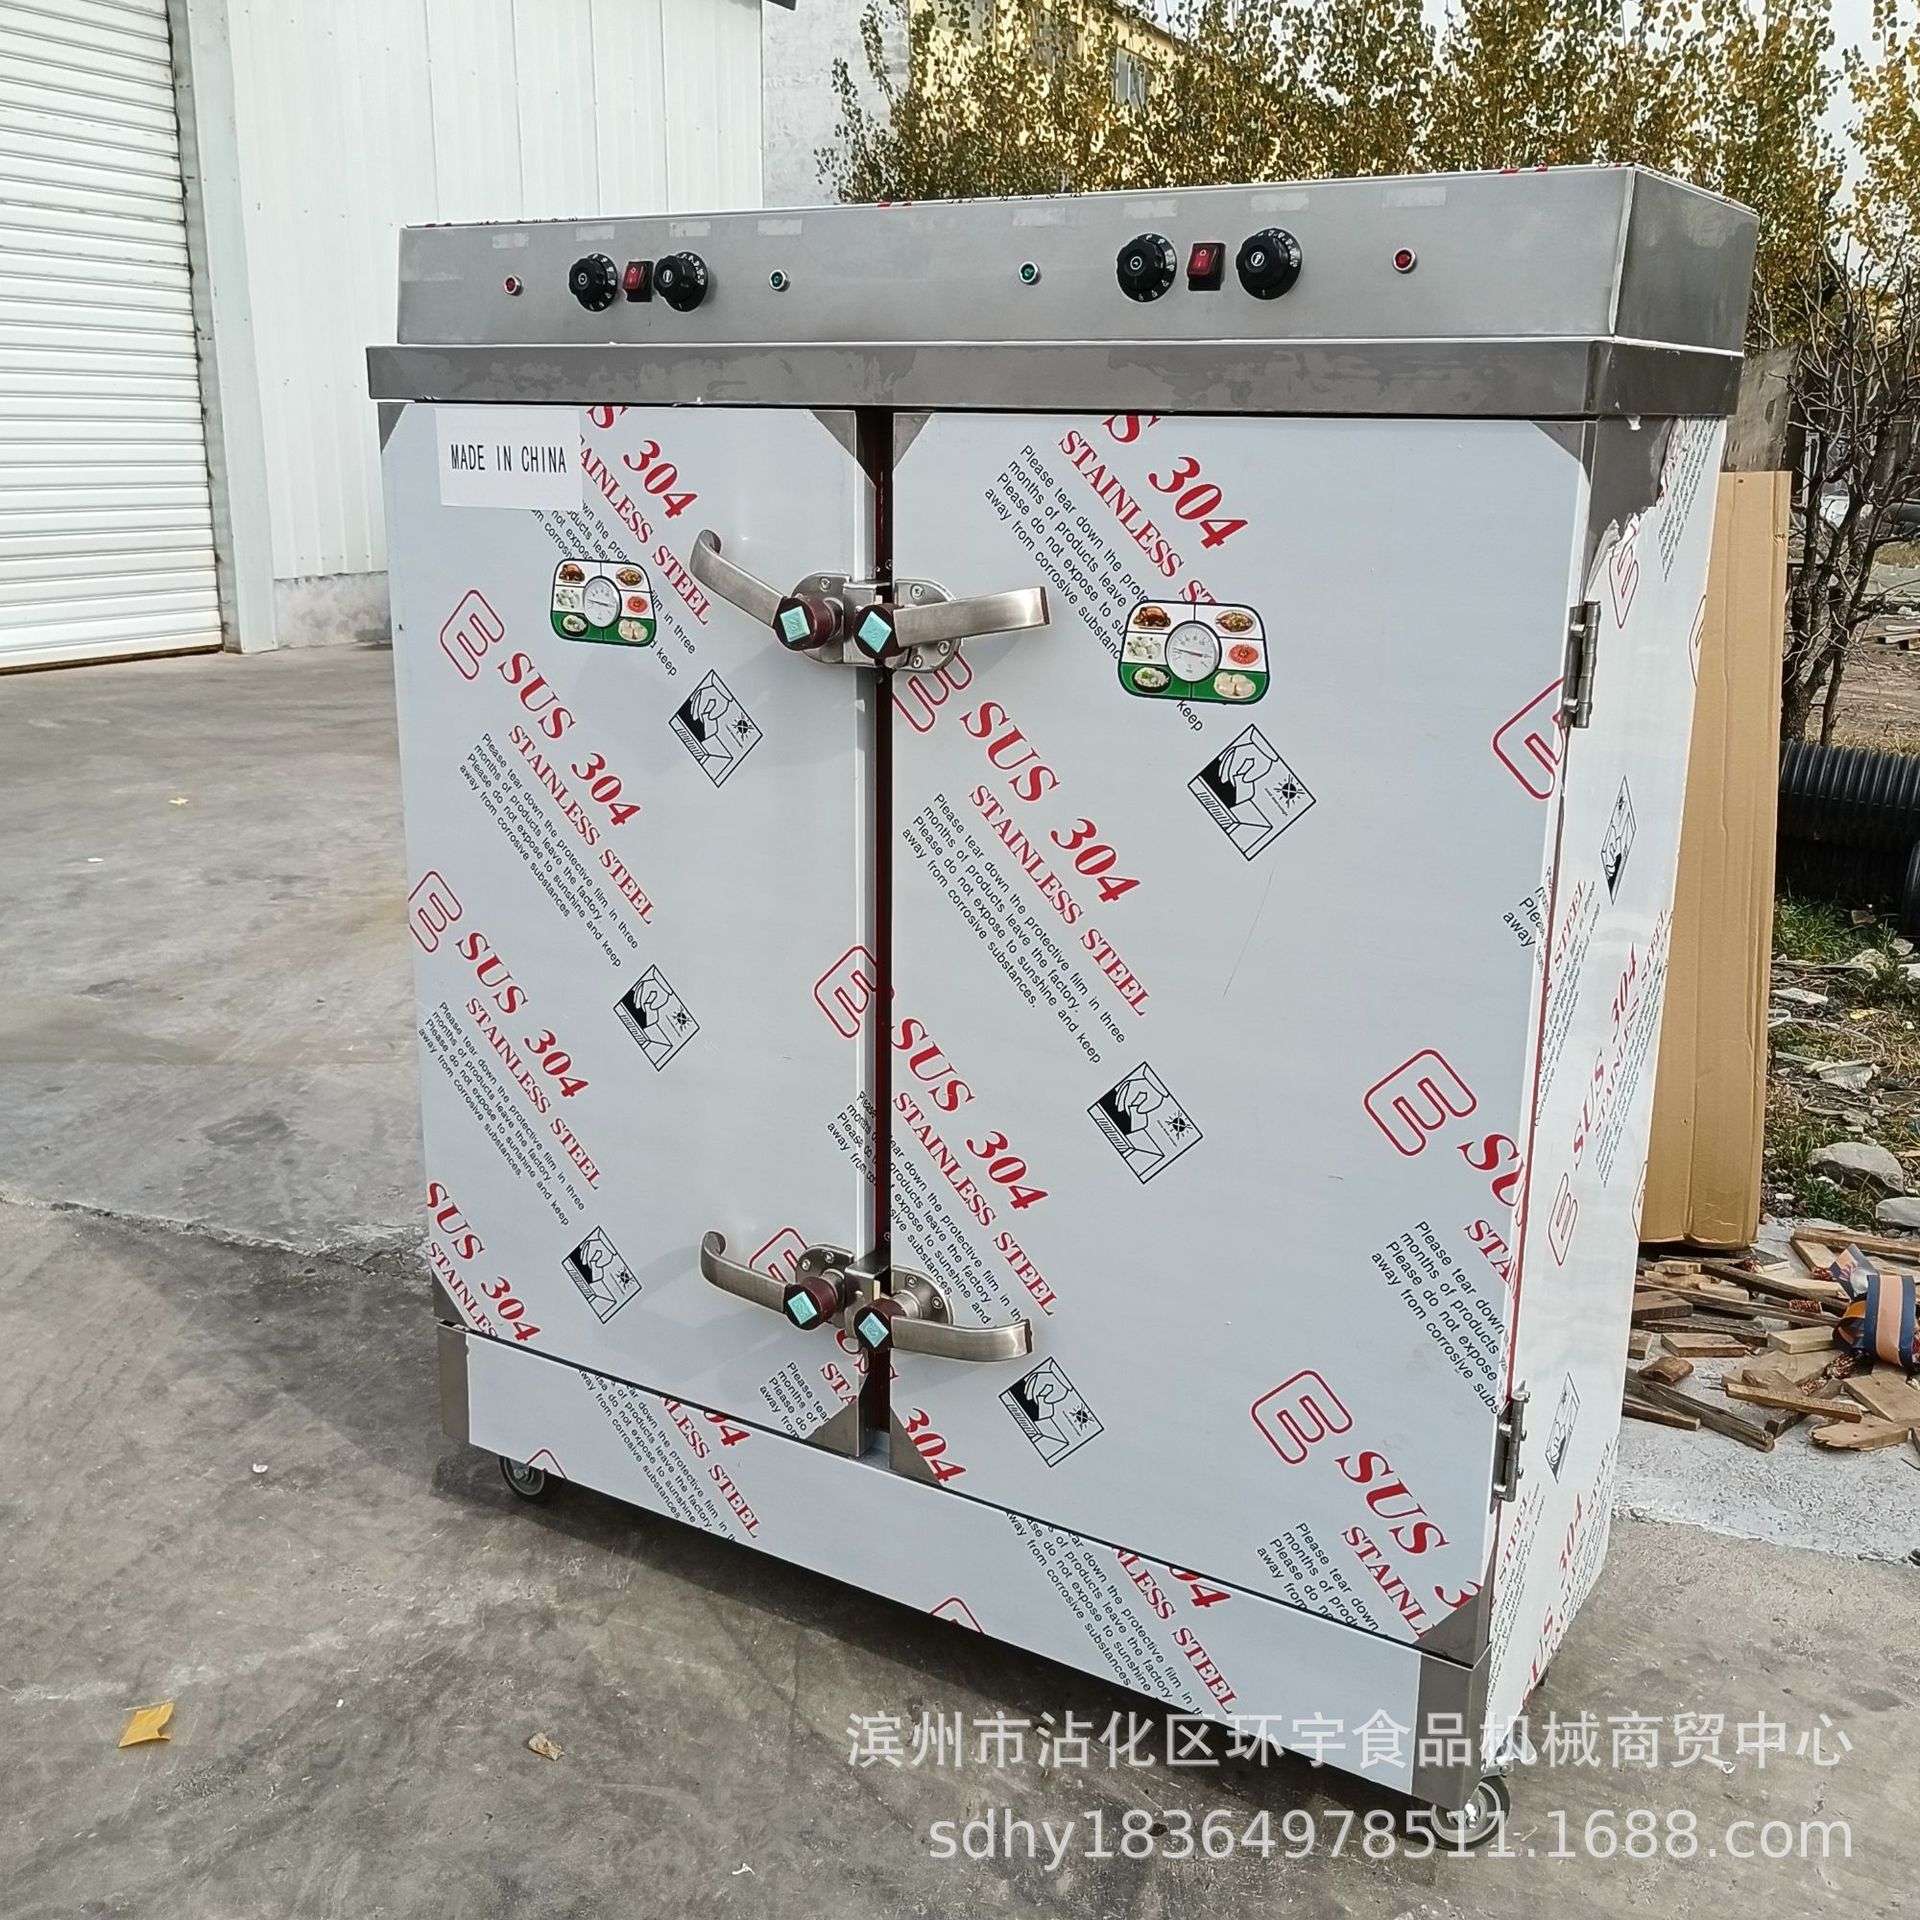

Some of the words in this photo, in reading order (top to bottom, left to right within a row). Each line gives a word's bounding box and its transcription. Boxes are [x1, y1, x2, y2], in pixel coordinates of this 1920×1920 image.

[450, 443, 486, 471] MADE
[496, 444, 512, 472] IN
[521, 445, 568, 474] CHINA
[622, 438, 698, 519] 304
[1018, 443, 1055, 488] Please
[1053, 486, 1078, 514] tear
[1074, 515, 1104, 550] down
[1102, 547, 1123, 572] the
[1056, 429, 1185, 578] STAINLESS
[1146, 455, 1249, 550] 304
[650, 544, 712, 626] STEEL
[983, 487, 1013, 522] away
[1010, 518, 1036, 552] from
[1033, 550, 1079, 605] corrosive
[995, 470, 1030, 516] Please
[1029, 515, 1046, 535] do
[1044, 534, 1066, 559] not
[1062, 557, 1099, 602] expose
[1097, 599, 1112, 618] to
[1175, 696, 1204, 732] keep
[1006, 459, 1045, 505] months
[1043, 504, 1061, 521] of
[1053, 519, 1099, 573] products
[1097, 569, 1127, 608] leave
[497, 651, 577, 740] SUS
[570, 751, 641, 826] 304
[958, 700, 1061, 804] SUS
[1049, 817, 1141, 903] 304
[458, 763, 481, 791] away
[478, 790, 498, 817] from
[496, 815, 530, 862] corrosive
[465, 751, 492, 789] Please
[491, 788, 504, 805] do
[502, 804, 518, 824] not
[515, 823, 544, 860] expose
[542, 858, 553, 873] to
[551, 872, 586, 919] sunshine
[584, 919, 605, 941] and
[600, 938, 622, 968] keep
[472, 743, 502, 782] months
[500, 781, 513, 794] of
[507, 793, 542, 838] products
[540, 835, 563, 866] leave
[561, 865, 577, 886] the
[480, 731, 507, 769] Please
[506, 767, 524, 790] tear
[522, 790, 545, 820] down
[542, 818, 558, 839] the
[555, 837, 594, 888] protective
[592, 886, 609, 909] film
[607, 906, 618, 922] in
[616, 919, 639, 949] three
[507, 724, 601, 846] STAINLESS
[597, 847, 654, 925] STEEL
[901, 827, 928, 859] away
[926, 858, 948, 889] from
[946, 888, 988, 940] corrosive
[986, 940, 1037, 1009] substances.
[911, 814, 944, 857] Please
[942, 857, 958, 875] do
[955, 875, 975, 897] not
[972, 896, 1006, 939] expose
[1004, 937, 1018, 954] to
[1016, 954, 1057, 1007] sunshine
[1056, 1008, 1080, 1033] and
[1075, 1030, 1101, 1064] keep
[921, 805, 956, 849] months
[954, 848, 971, 863] of
[963, 863, 1006, 913] products
[1003, 911, 1031, 947] leave
[1029, 945, 1048, 969] the
[1046, 967, 1080, 1014] factory.
[932, 792, 965, 834] Please
[963, 833, 985, 859] tear
[983, 860, 1010, 893] down
[1008, 892, 1026, 915] the
[1022, 915, 1070, 972] protective
[1068, 971, 1089, 996] film
[1086, 994, 1100, 1012] in
[1098, 1009, 1125, 1044] three
[967, 784, 1084, 925] STAINLESS
[1078, 927, 1150, 1017] STEEL
[1502, 910, 1537, 948] away
[453, 931, 529, 1015] SUS
[523, 1027, 589, 1098] 304
[464, 996, 552, 1114] STAINLESS
[548, 1117, 601, 1191] STEEL
[826, 1121, 852, 1152] away
[891, 1016, 976, 1114] SUS
[964, 1129, 1049, 1210] 304
[425, 1181, 486, 1260] SUS
[479, 1275, 541, 1348] 304
[888, 1091, 997, 1227] STAINLESS
[991, 1230, 1057, 1317] STEEL
[888, 1192, 924, 1233] expose
[922, 1232, 935, 1248] to
[933, 1248, 971, 1299] sunshine
[970, 1300, 992, 1325] and
[902, 1160, 928, 1192] down
[925, 1191, 943, 1213] the
[938, 1213, 983, 1269] protective
[981, 1268, 1000, 1292] film
[998, 1291, 1011, 1307] in
[921, 1208, 947, 1242] leave
[945, 1242, 963, 1264] the
[1370, 1251, 1402, 1286] away
[1399, 1287, 1427, 1320] from
[1424, 1321, 1474, 1380] corrosive
[1384, 1239, 1423, 1286] Please
[1421, 1288, 1440, 1307] do
[1437, 1309, 1461, 1333] not
[1457, 1334, 1498, 1382] expose
[1398, 1231, 1440, 1280] months
[1438, 1281, 1458, 1297] of
[1448, 1298, 1500, 1355] products
[1413, 1219, 1453, 1266] Please
[1450, 1266, 1477, 1295] tear
[1474, 1298, 1505, 1335] down
[706, 1463, 760, 1539] STEEL
[1255, 1546, 1285, 1579] away
[1268, 1537, 1304, 1581] Please
[1302, 1583, 1319, 1602] do
[1281, 1530, 1319, 1577] months
[1317, 1578, 1336, 1593] of
[1333, 1450, 1450, 1556] SUS
[1054, 1534, 1069, 1549] of
[1062, 1549, 1104, 1600] products
[1100, 1600, 1127, 1634] leave
[1125, 1635, 1144, 1657] the
[1081, 1551, 1107, 1584] down
[1105, 1583, 1123, 1605] the
[1119, 1607, 1165, 1664] protective
[1163, 1665, 1182, 1689] film
[1180, 1690, 1193, 1705] in
[1294, 1521, 1330, 1566] Please
[1328, 1566, 1353, 1593] tear
[1349, 1596, 1379, 1635] down
[1169, 1626, 1237, 1715] STEEL
